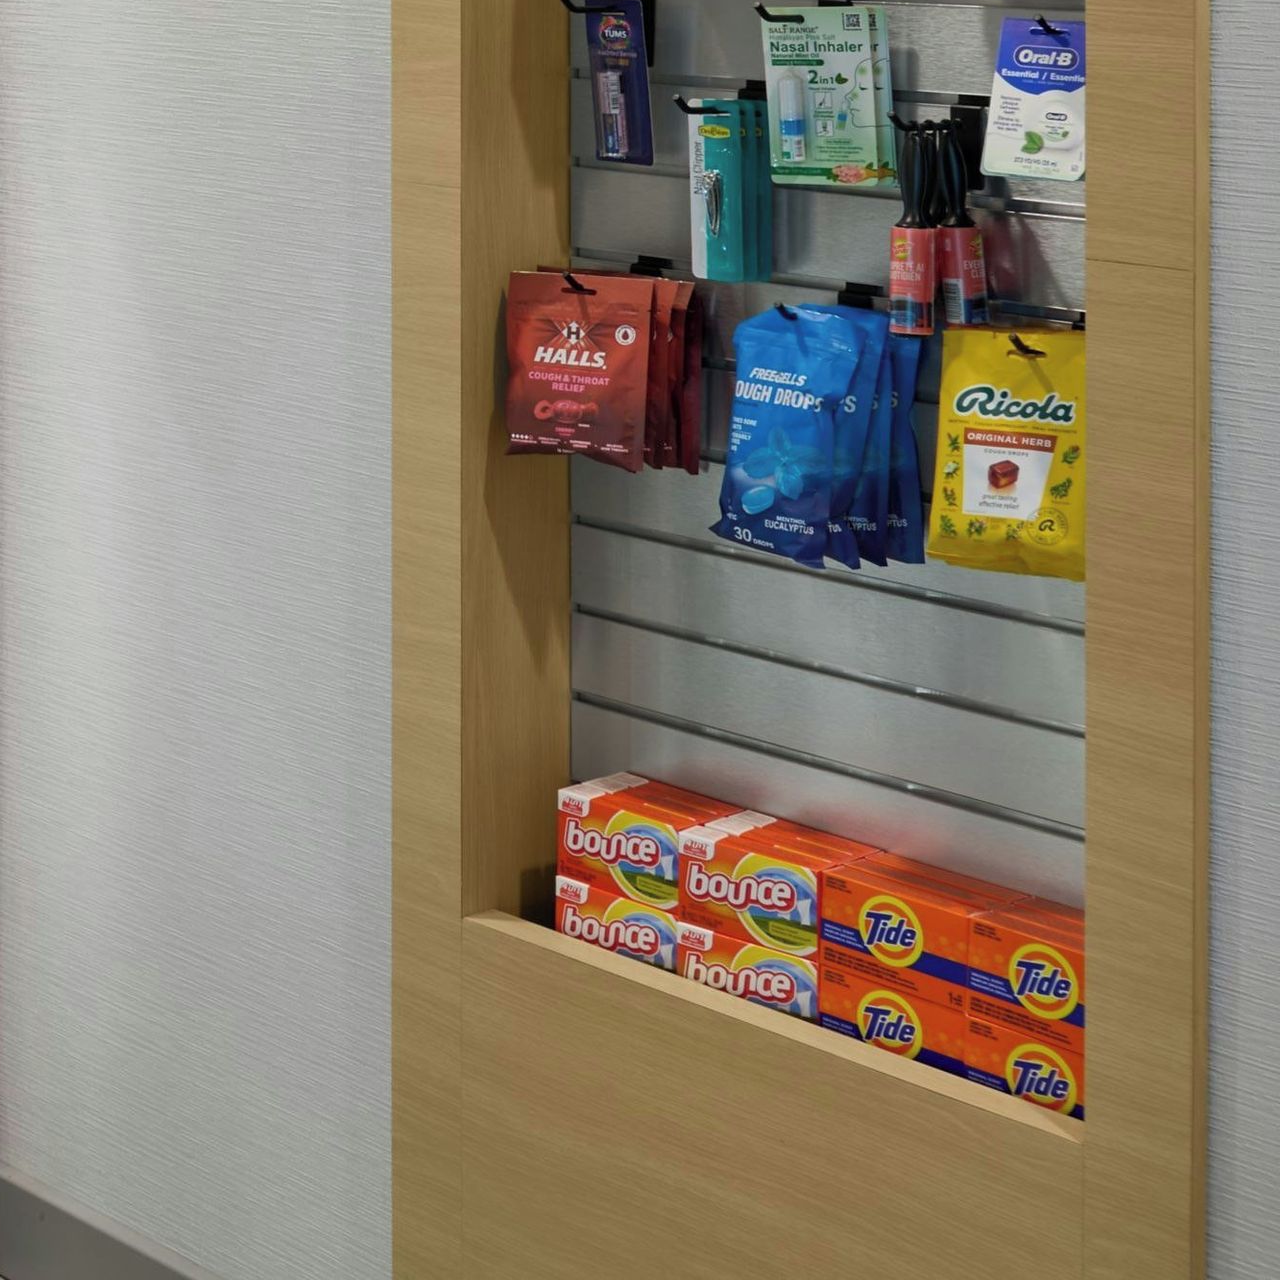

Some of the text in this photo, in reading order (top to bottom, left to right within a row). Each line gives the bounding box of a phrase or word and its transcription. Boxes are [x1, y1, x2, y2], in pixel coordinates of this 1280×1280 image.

[604, 29, 627, 39] TUMS
[770, 42, 862, 52] Nasal Inhaler
[1018, 49, 1072, 66] Oral-B
[1001, 69, 1039, 80] Essential
[694, 141, 702, 174] Clipper
[529, 371, 610, 386] COUGH THROAT
[552, 382, 585, 392] RELIEF
[749, 367, 807, 386] FREEGELLS
[774, 388, 825, 413] DROPS
[956, 386, 1074, 423] Ricola
[967, 432, 1052, 448] ORIGINAL HERB
[734, 526, 752, 542] 30
[764, 519, 814, 535] EUCALYPTUS
[564, 818, 659, 866] bounce
[687, 862, 795, 911] bounce
[564, 904, 658, 954] bounce
[866, 912, 916, 948] Tide
[686, 952, 795, 1001] bounce
[1016, 960, 1072, 999] Tide
[863, 1006, 916, 1044] Tide
[1013, 1060, 1069, 1099] Tide
